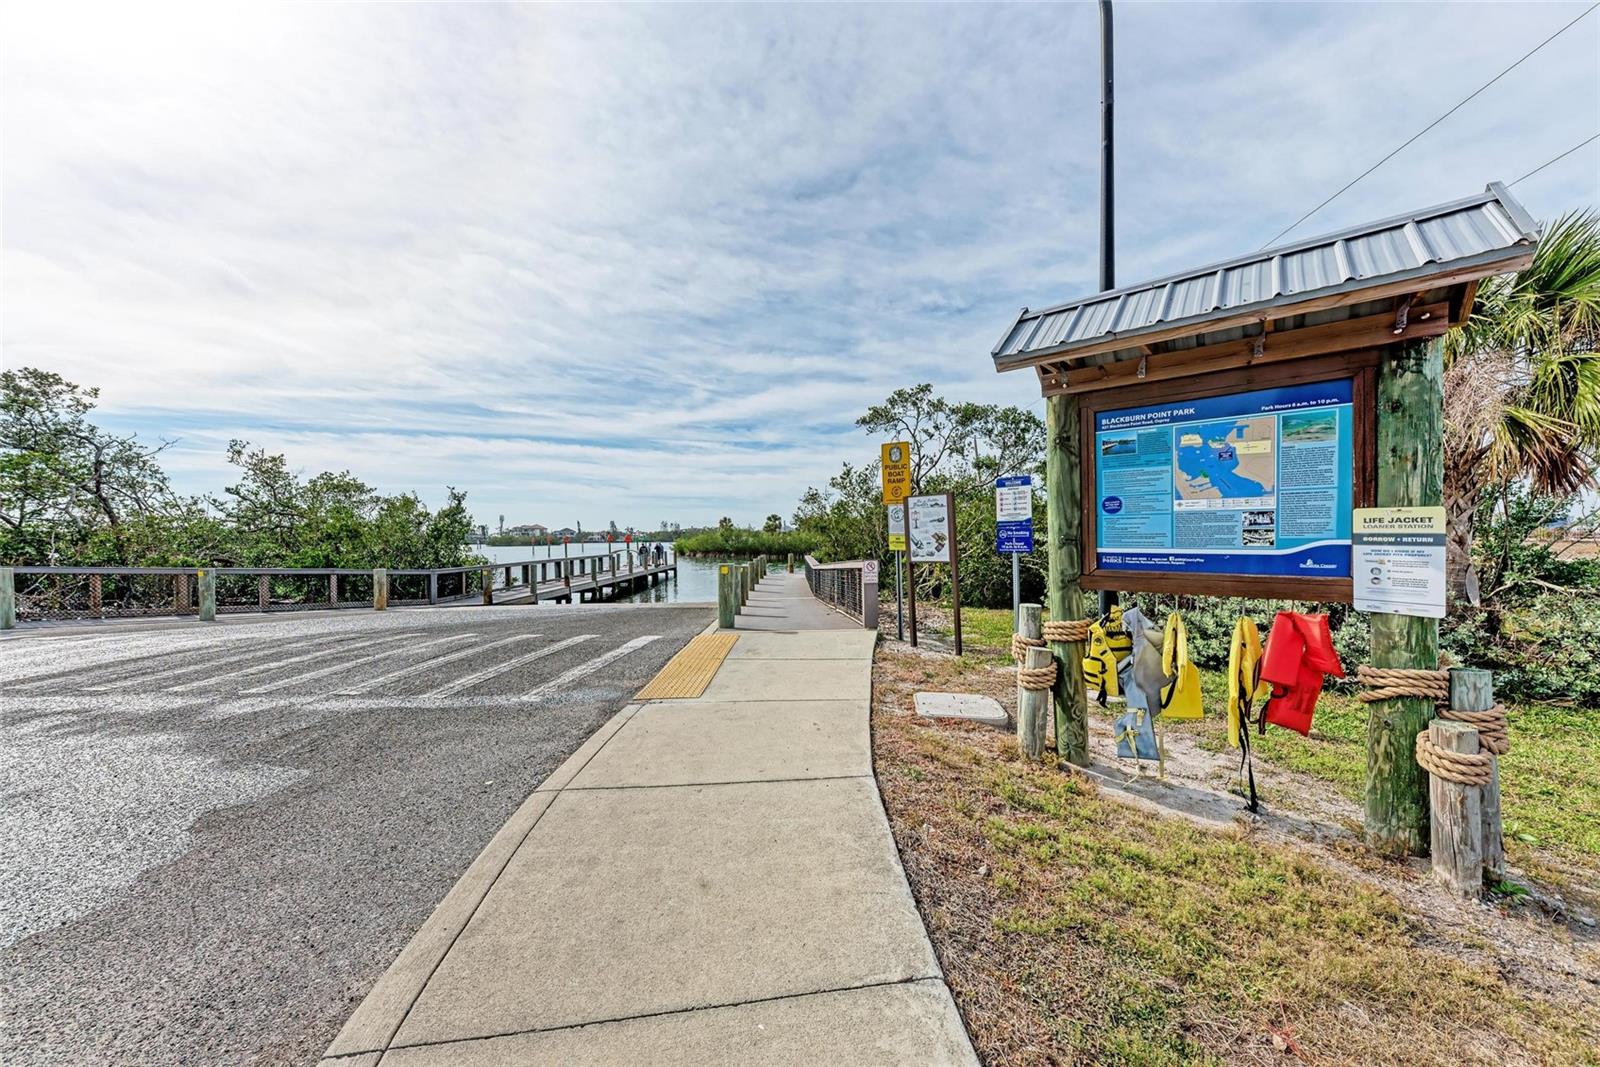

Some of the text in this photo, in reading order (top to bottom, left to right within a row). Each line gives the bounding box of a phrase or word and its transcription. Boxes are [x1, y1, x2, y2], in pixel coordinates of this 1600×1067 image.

[1102, 408, 1195, 425] BLACKBURN POINT PARK
